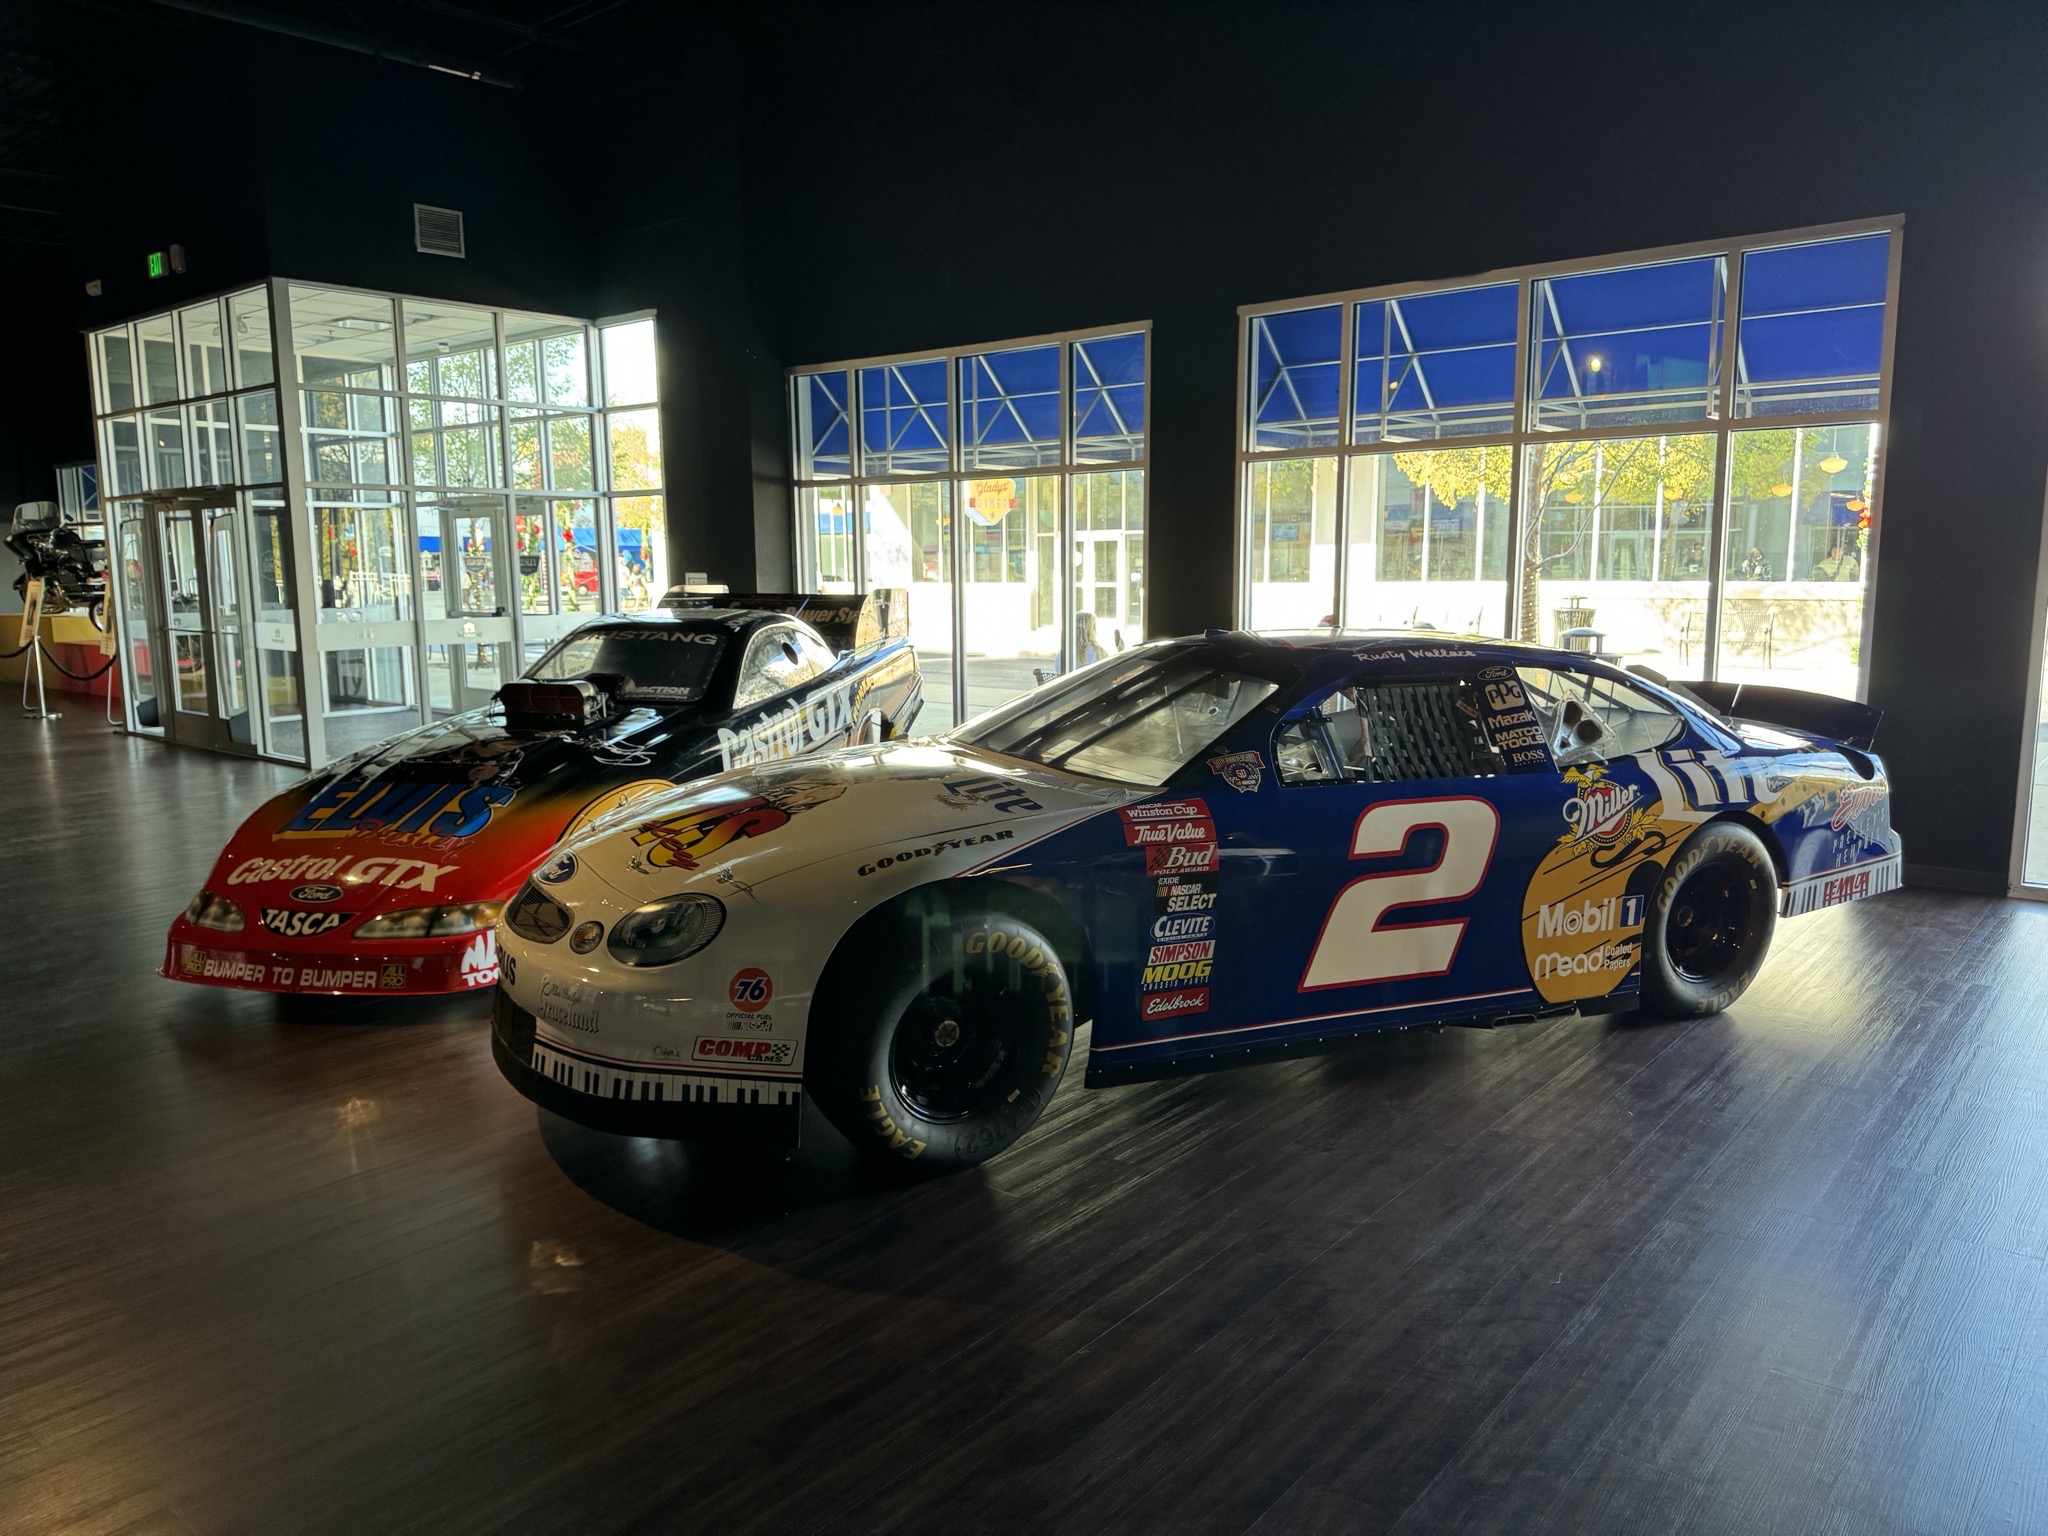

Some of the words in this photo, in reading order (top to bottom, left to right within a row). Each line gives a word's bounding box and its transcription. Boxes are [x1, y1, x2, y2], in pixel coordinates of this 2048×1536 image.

[150, 253, 162, 276] EXIT
[977, 498, 1008, 508] DINER
[1352, 650, 1406, 661] Rusty
[1407, 648, 1476, 658] Wallace
[1484, 669, 1508, 679] Ford
[1487, 682, 1522, 704] PPG
[717, 698, 804, 771] Castrol
[807, 686, 852, 741] GTX
[1488, 710, 1537, 730] Mazak
[1495, 726, 1542, 742] MATCO
[1498, 735, 1546, 751] TOOLS
[1512, 749, 1545, 763] BOSS
[1236, 768, 1247, 778] 50
[943, 776, 1043, 813] Lite
[273, 781, 518, 840] ELVIS
[1127, 806, 1174, 818] Winston
[1174, 804, 1198, 816] Cup
[1563, 785, 1641, 840] Miller
[858, 830, 1015, 877] GOODYEAR
[1164, 844, 1216, 868] Bud
[227, 855, 354, 885] Castrol
[350, 857, 461, 893] GTX
[297, 885, 332, 901] Ford
[1171, 884, 1202, 896] NASCAR
[1298, 795, 1500, 993] 2
[1167, 893, 1217, 912] SELECT
[264, 909, 341, 937] TASCA
[1154, 916, 1211, 938] CLEVITE
[1537, 897, 1617, 938] Mobil
[190, 951, 205, 962] ALL
[1151, 942, 1212, 964] SIMPSON
[1604, 942, 1634, 957] Coated
[186, 962, 203, 974] PRO
[384, 965, 405, 977] ALL
[1141, 960, 1213, 985] MOOG
[1604, 957, 1631, 971] Papers
[203, 960, 265, 982] BUMPER
[273, 967, 294, 985] TO
[300, 969, 377, 988] BUMPER
[382, 976, 404, 987] PRO
[1143, 980, 1178, 991] CHASSIS
[1183, 976, 1209, 986] PARTS
[735, 978, 768, 1002] 76
[965, 931, 1070, 1078] GOODYEAR
[1146, 993, 1205, 1014] Edelbrock
[726, 1012, 755, 1020] OFFICIAL
[698, 1039, 773, 1058] COMP
[747, 1054, 783, 1063] CAMS
[862, 1084, 927, 1161] EAGLE
